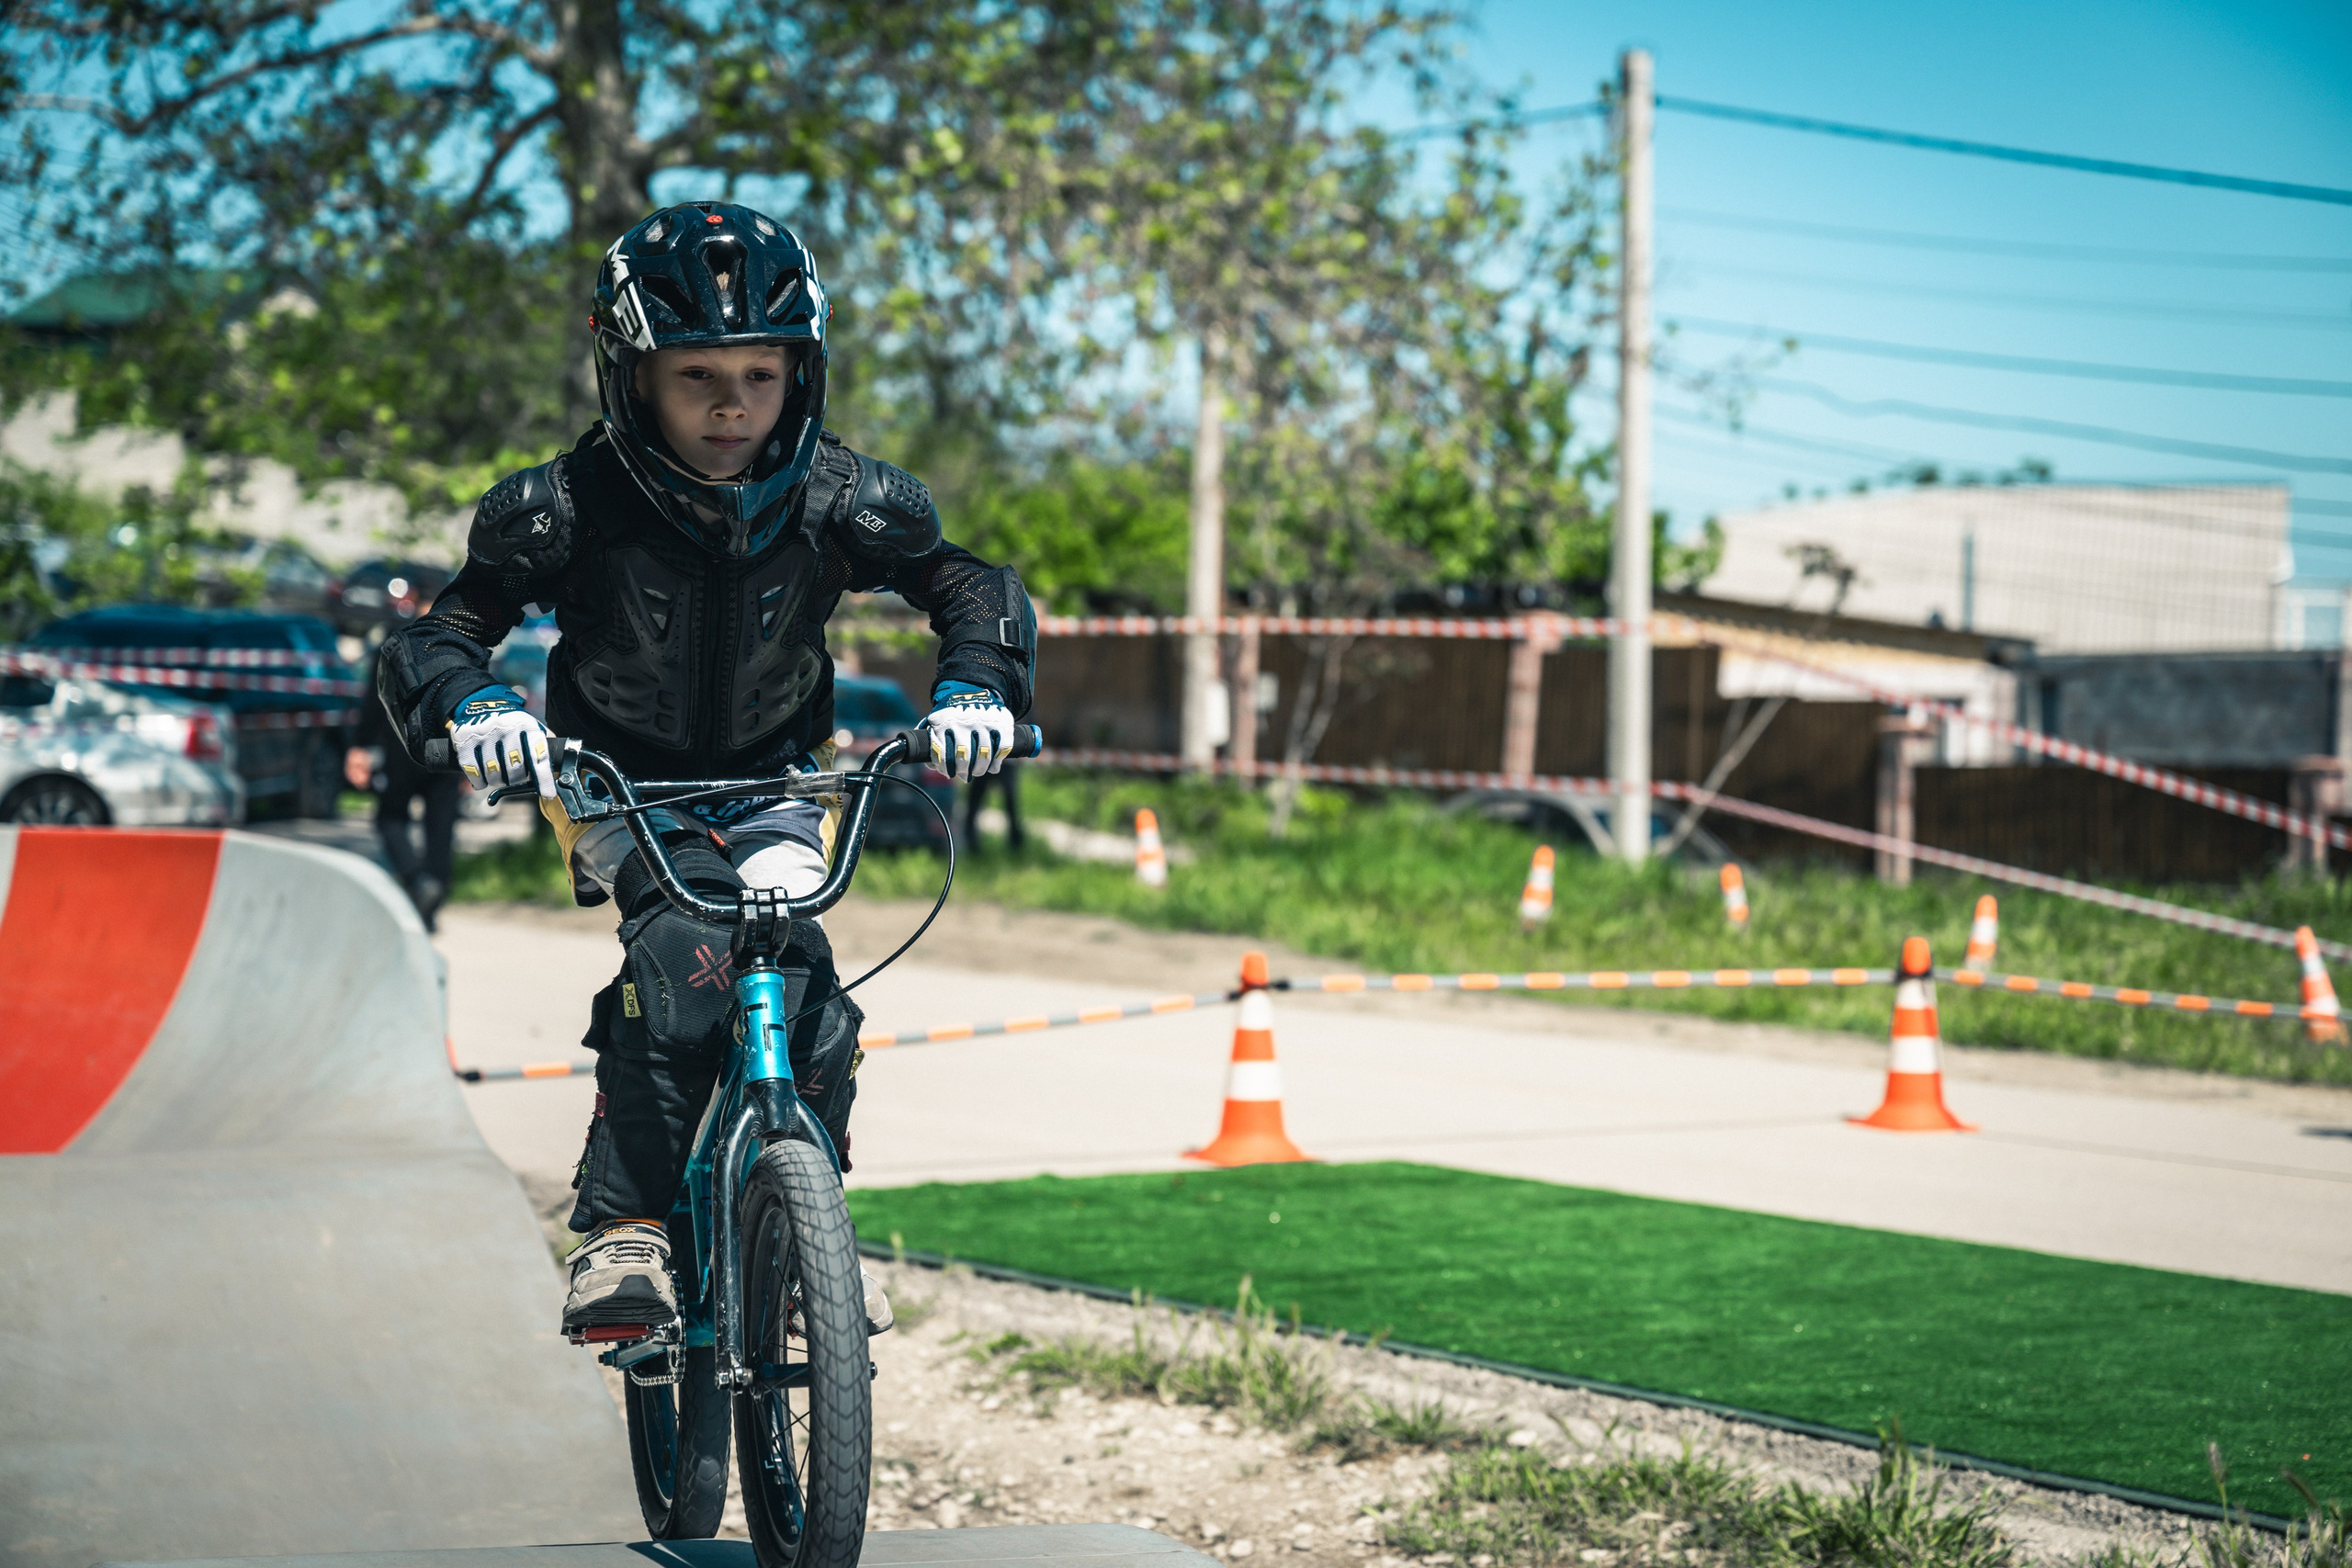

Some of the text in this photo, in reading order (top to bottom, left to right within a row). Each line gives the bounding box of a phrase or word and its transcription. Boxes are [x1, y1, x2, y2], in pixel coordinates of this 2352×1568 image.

[606, 235, 657, 351] MET
[627, 998, 636, 1016] DFS
[604, 1226, 637, 1236] GEOX
